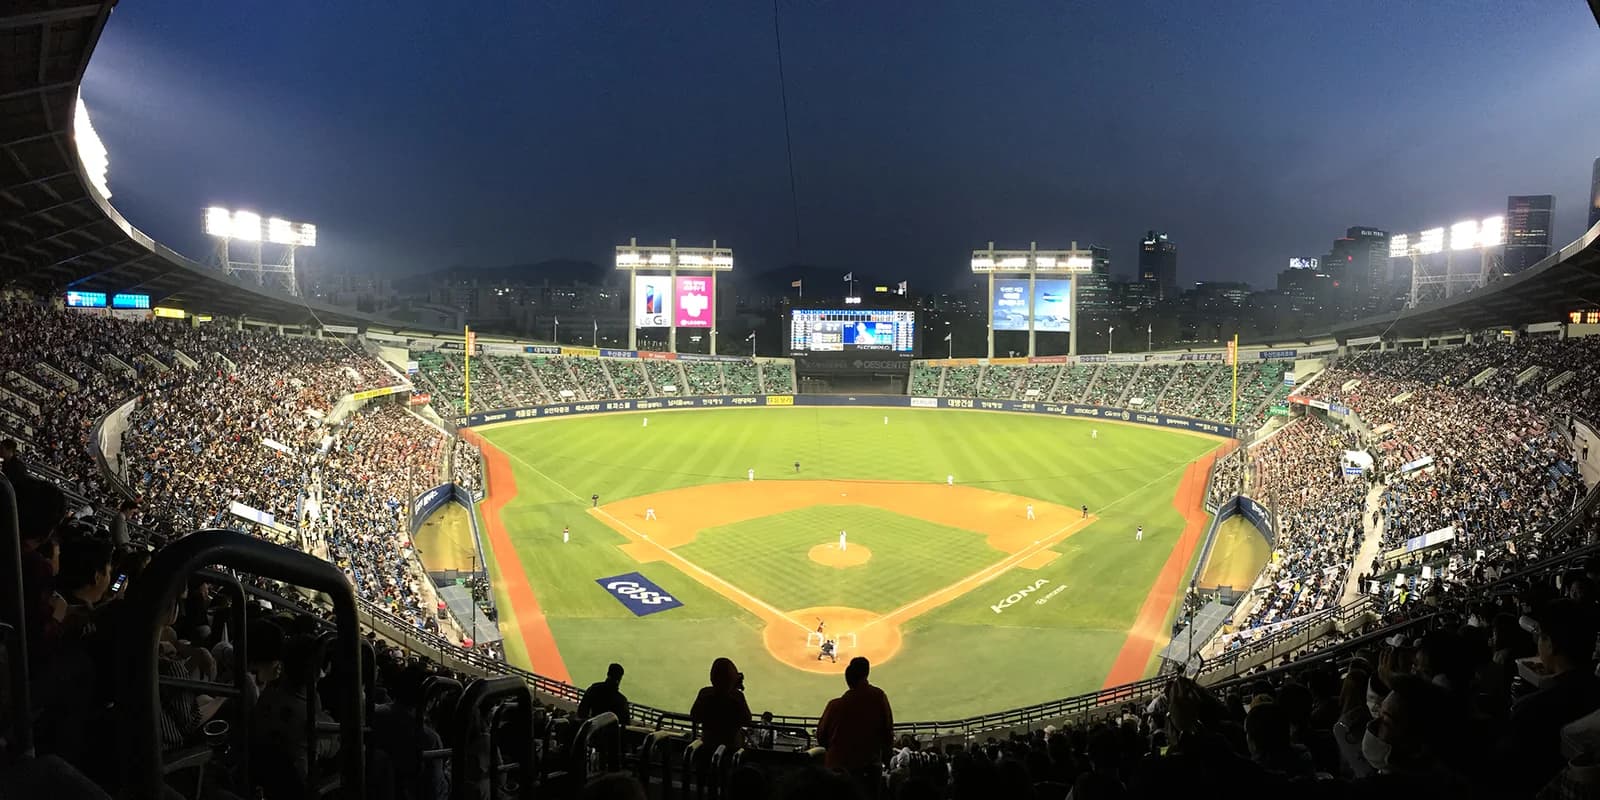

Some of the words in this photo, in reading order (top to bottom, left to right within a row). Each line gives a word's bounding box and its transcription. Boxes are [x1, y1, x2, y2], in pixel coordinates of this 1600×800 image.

[864, 359, 907, 369] DESCENTE
[607, 581, 672, 605] Cass
[990, 578, 1050, 614] KONA
